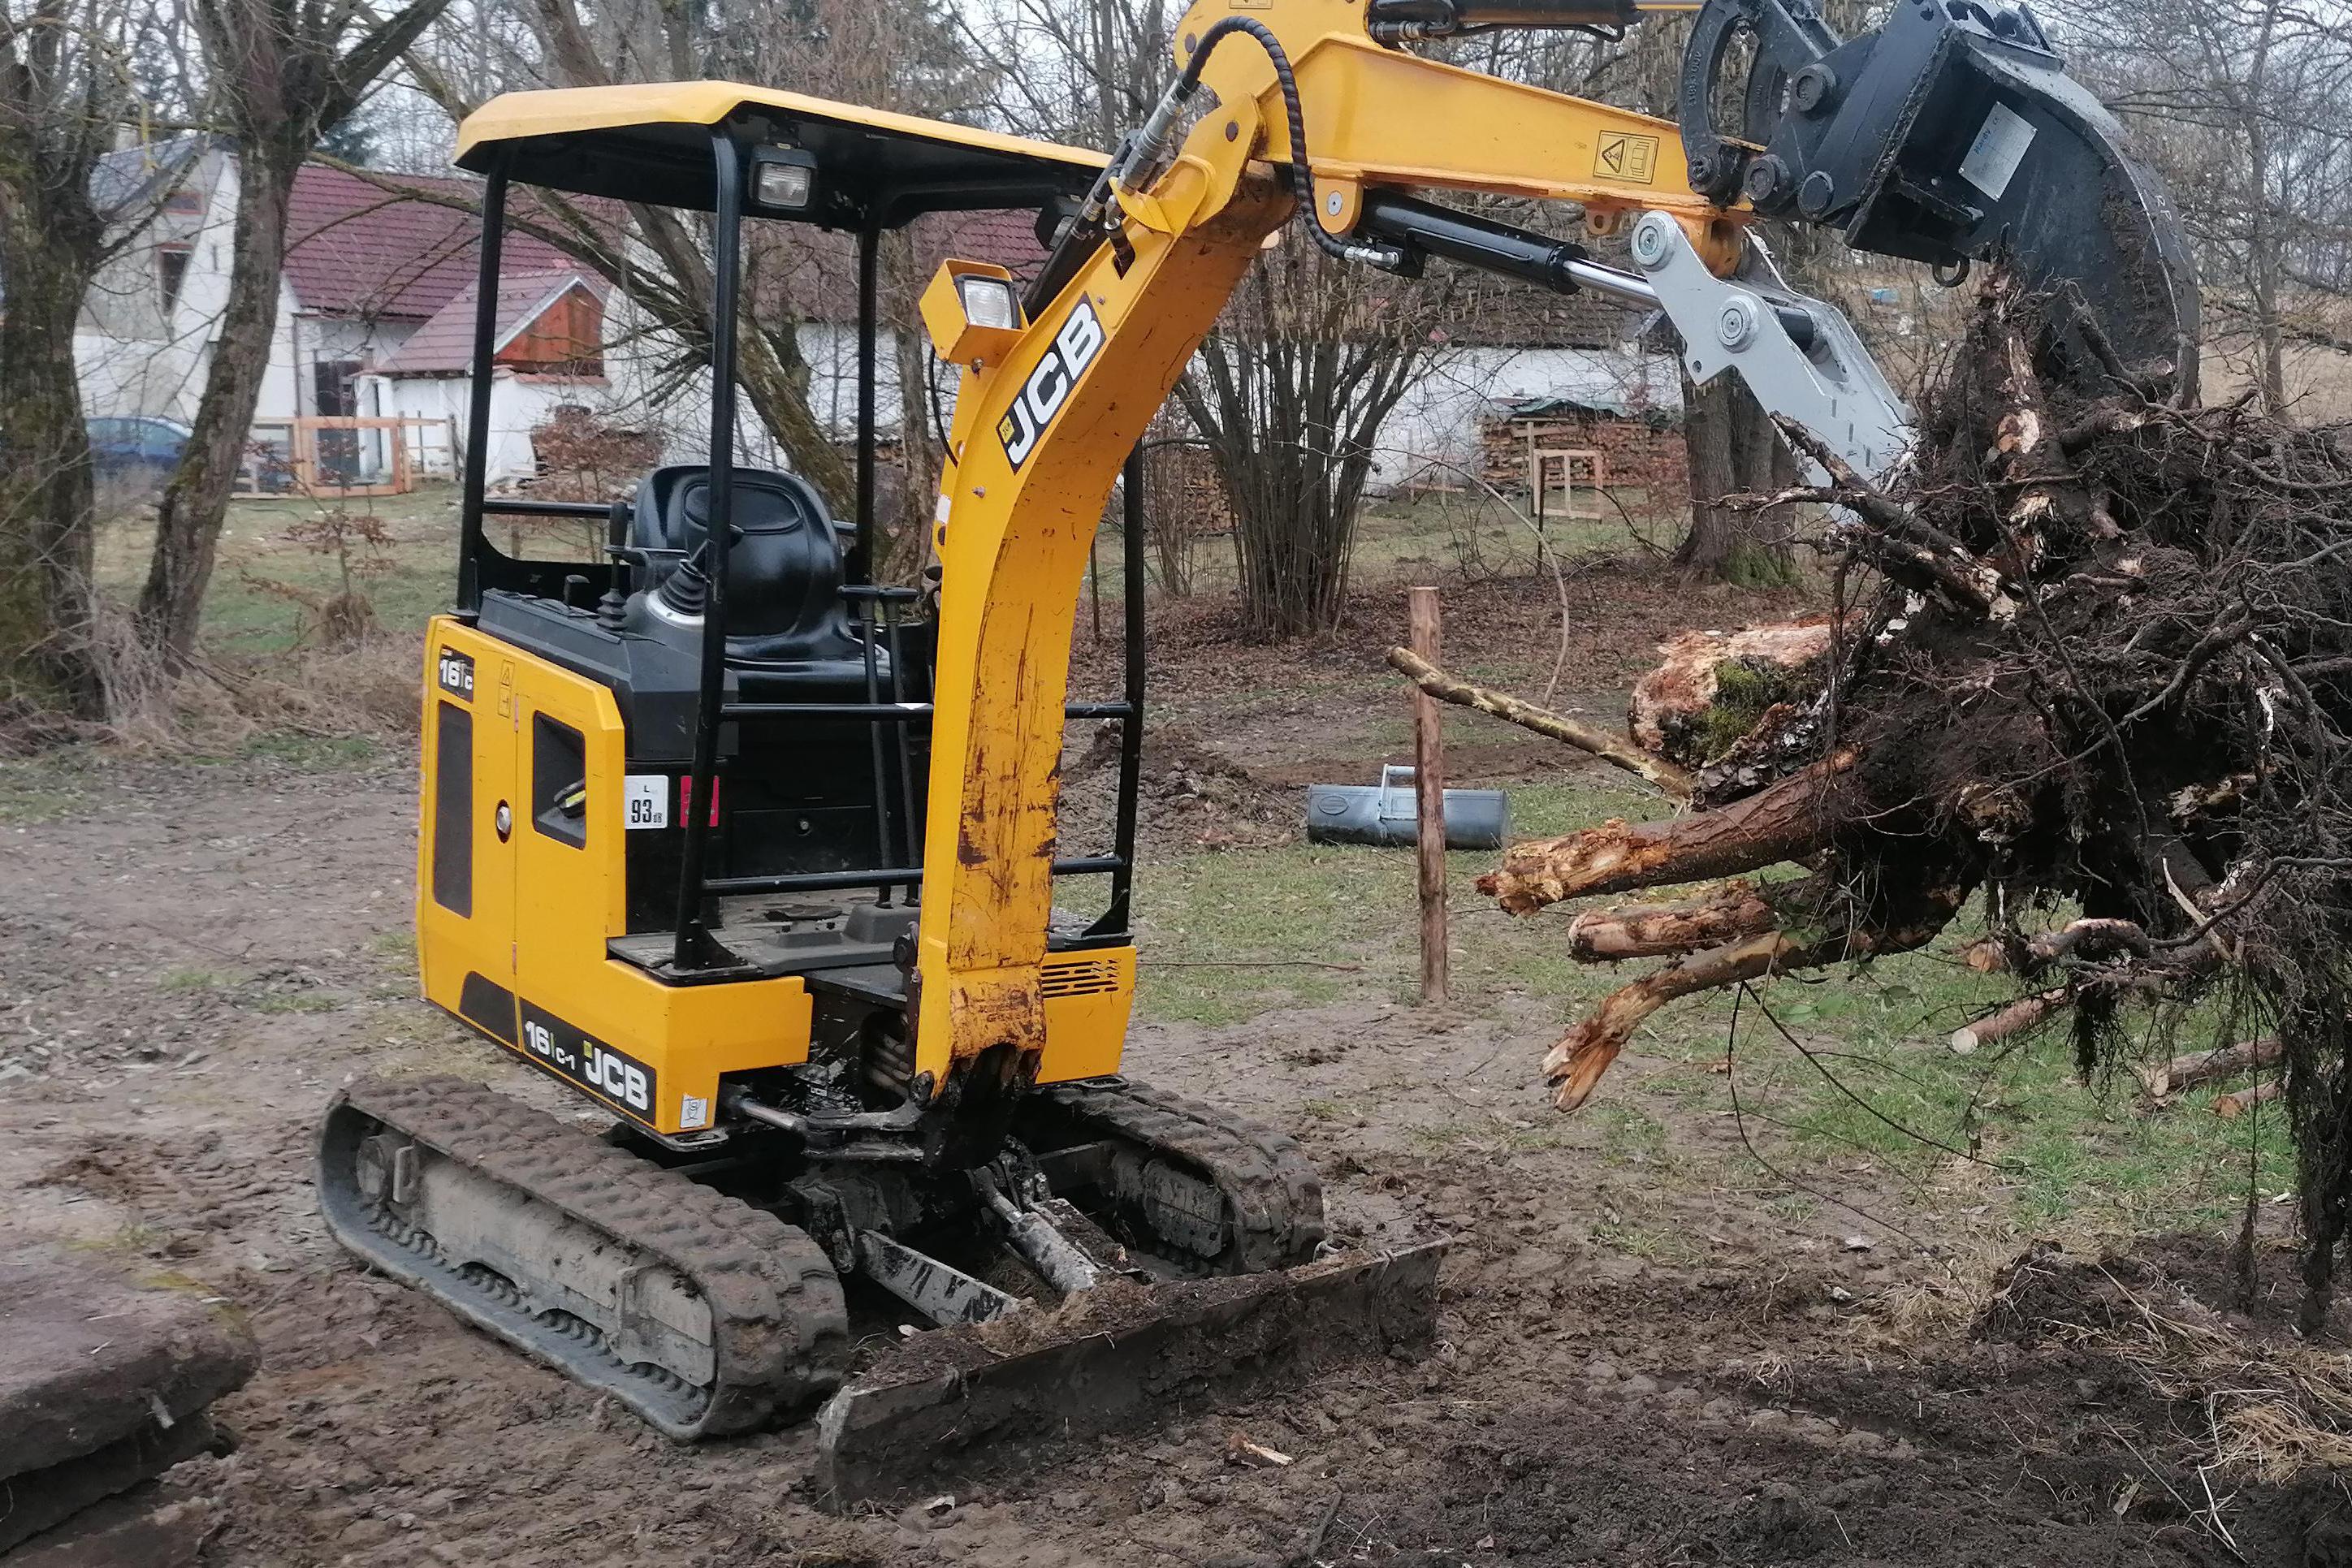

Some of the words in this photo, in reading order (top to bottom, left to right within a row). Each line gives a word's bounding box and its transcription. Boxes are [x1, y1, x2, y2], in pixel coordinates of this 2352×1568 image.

[1007, 303, 1102, 464] JCB
[631, 799, 651, 823] 93
[585, 1047, 648, 1110] JCB
